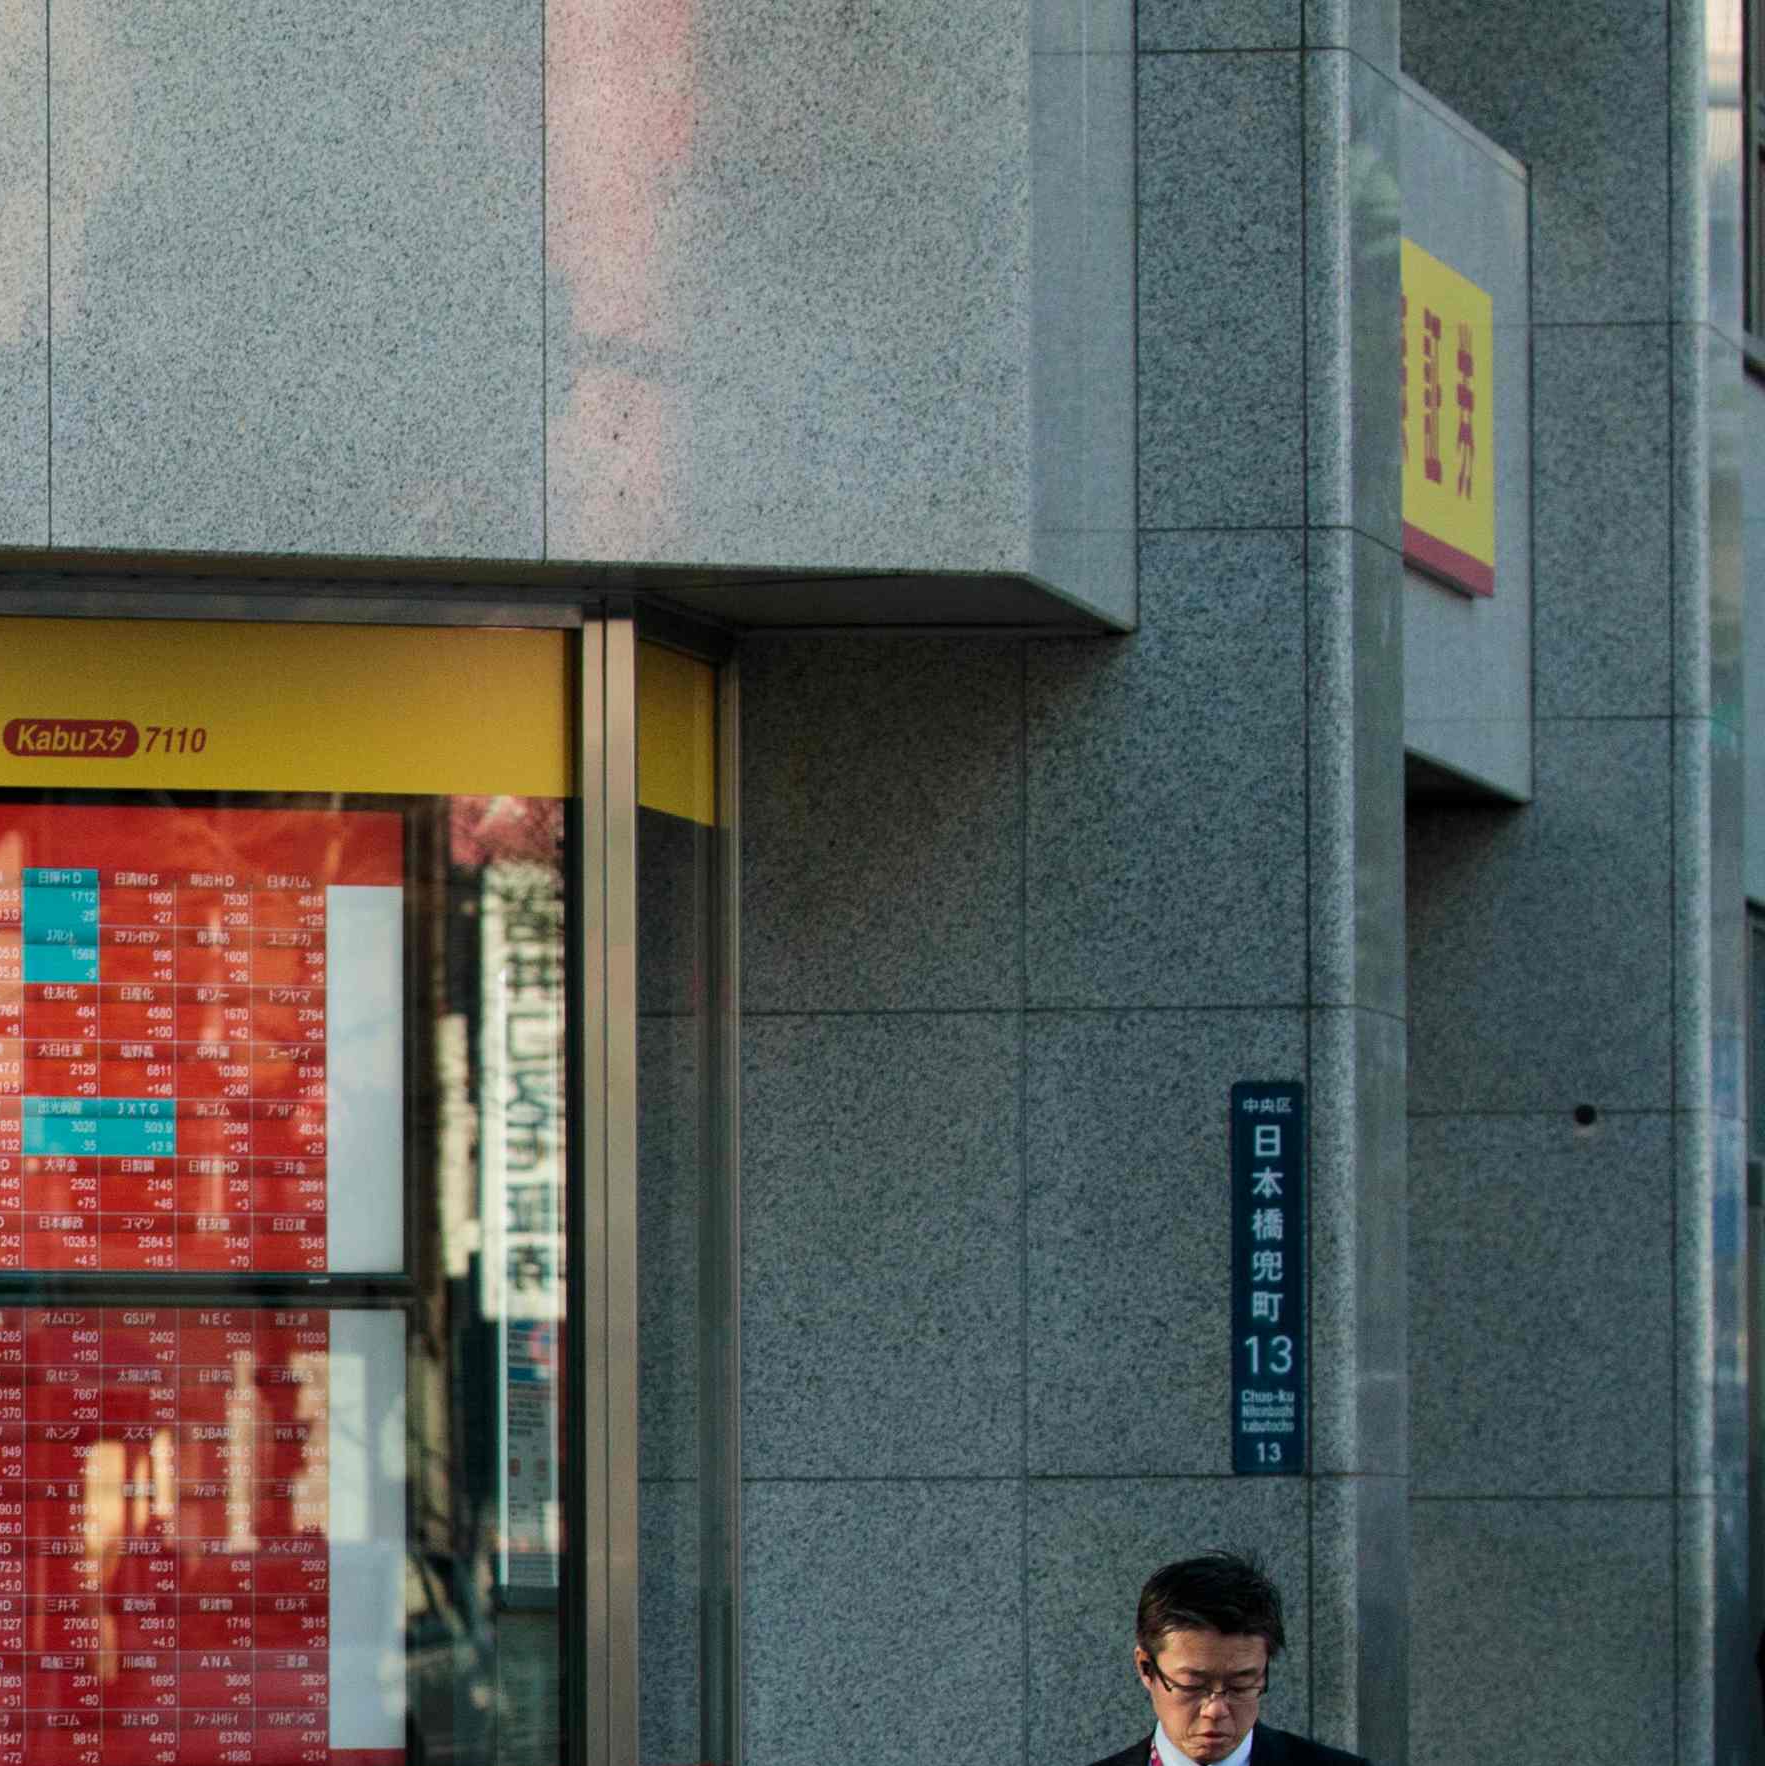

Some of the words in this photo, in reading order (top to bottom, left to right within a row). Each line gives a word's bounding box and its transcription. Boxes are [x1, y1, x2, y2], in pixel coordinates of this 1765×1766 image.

[15, 723, 127, 756] Kabuスタ
[144, 726, 208, 755] 7110
[1242, 1097, 1292, 1114] 中央区
[1252, 1124, 1285, 1323] 日本橋兜町
[1244, 1335, 1293, 1376] 13
[1257, 1441, 1283, 1464] 13
